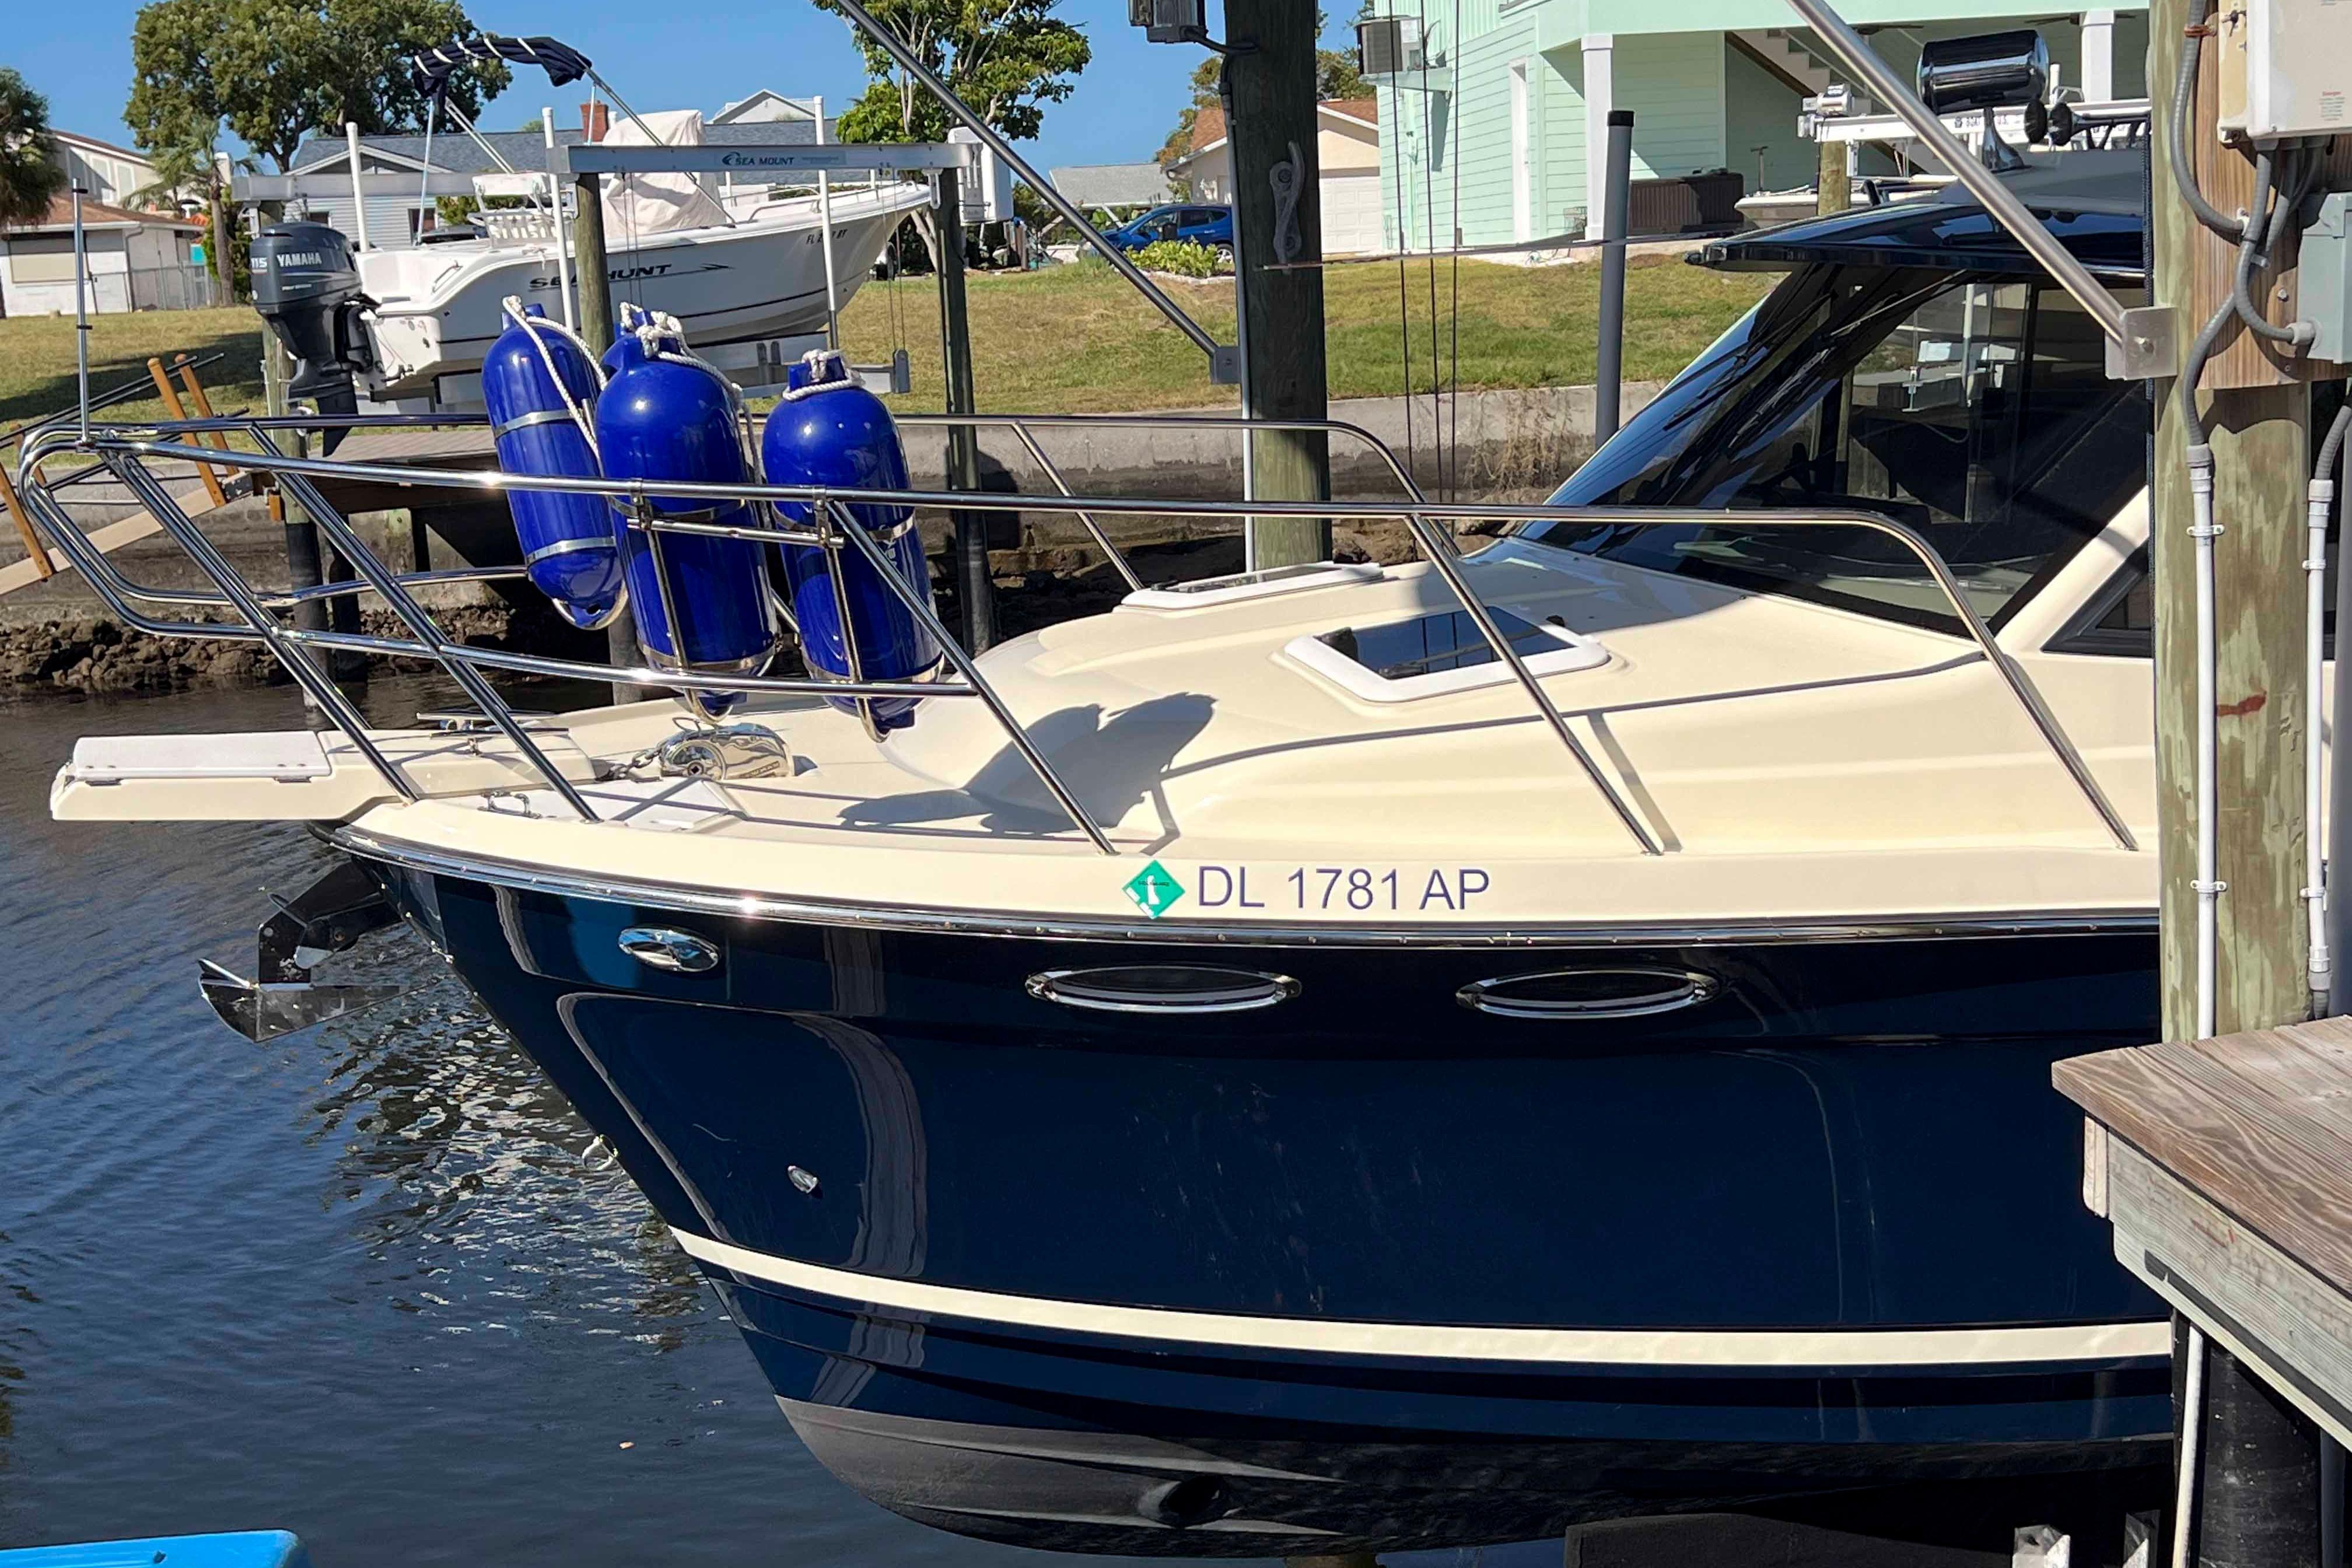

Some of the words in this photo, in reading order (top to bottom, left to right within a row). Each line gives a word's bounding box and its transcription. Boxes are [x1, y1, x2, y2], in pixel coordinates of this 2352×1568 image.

[735, 157, 755, 166] SEA
[760, 157, 795, 165] MOUNT
[251, 257, 268, 268] 115
[276, 252, 323, 267] YAMAHA
[1199, 866, 1265, 907] DL
[1288, 867, 1396, 910] 1781
[1419, 869, 1489, 910] AP
